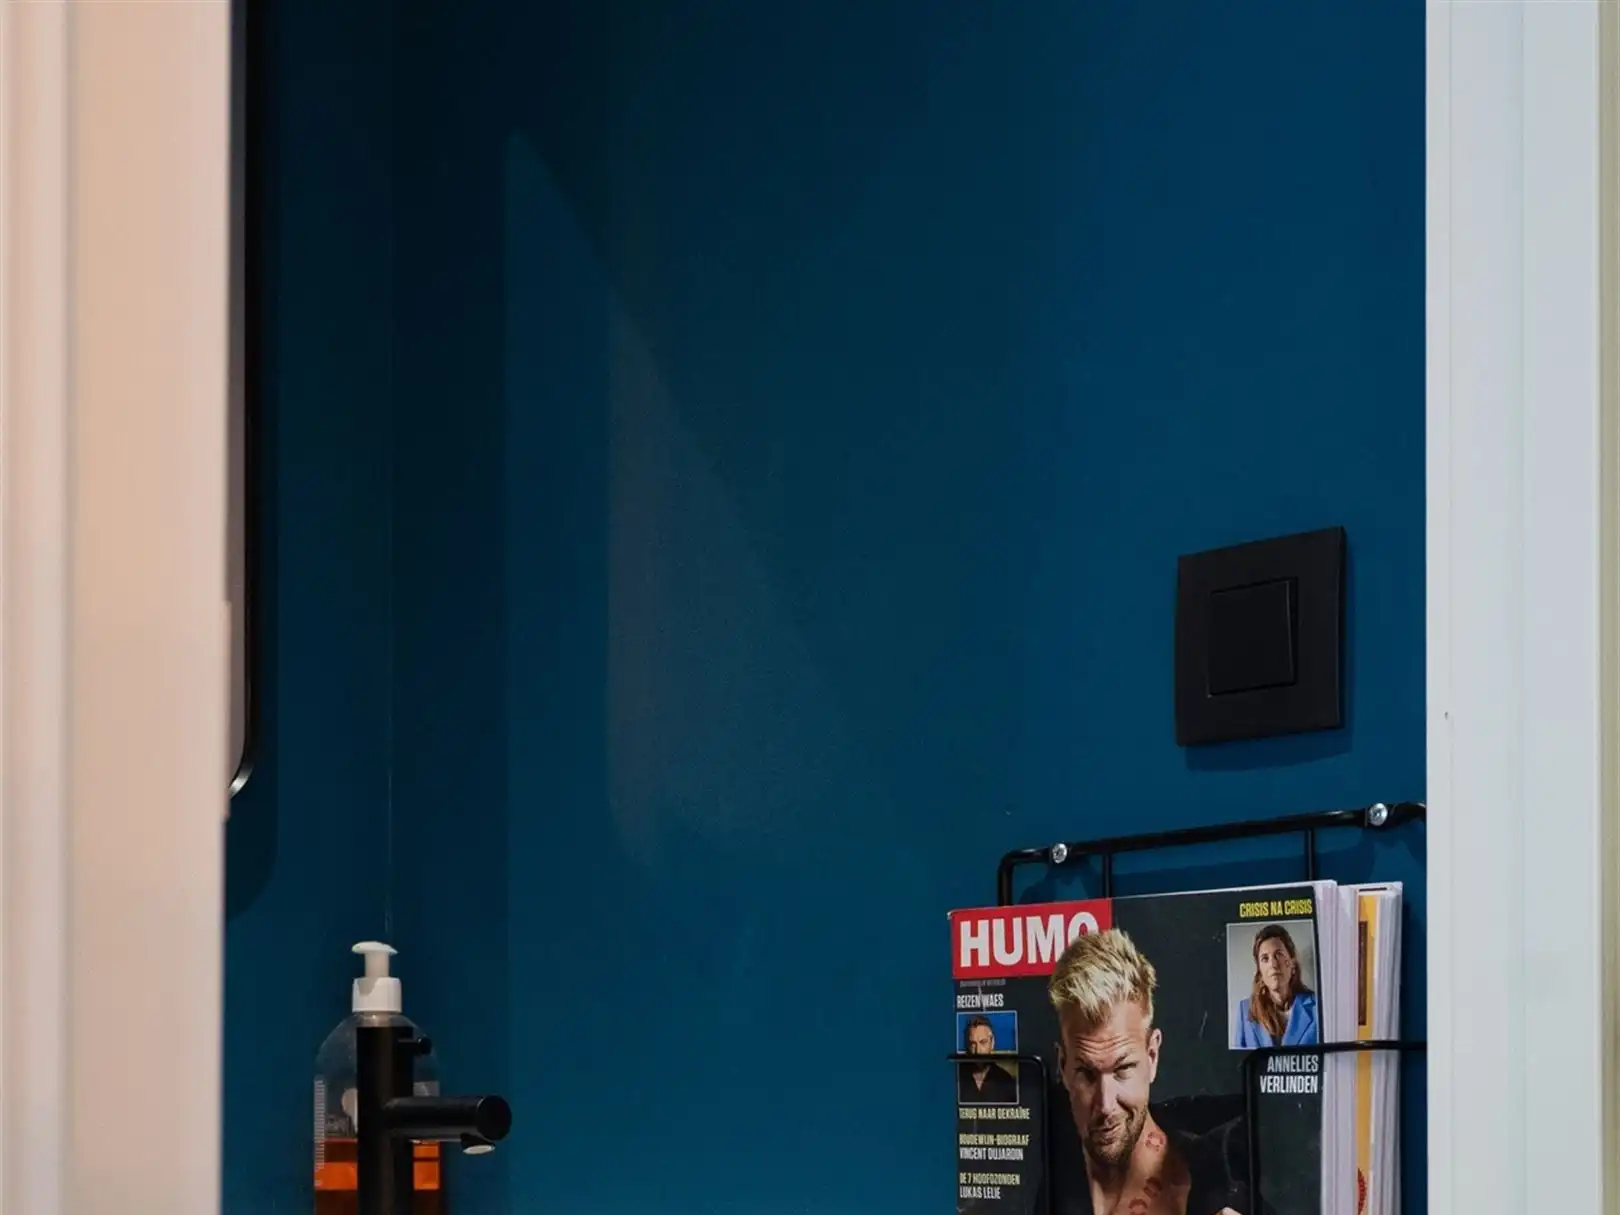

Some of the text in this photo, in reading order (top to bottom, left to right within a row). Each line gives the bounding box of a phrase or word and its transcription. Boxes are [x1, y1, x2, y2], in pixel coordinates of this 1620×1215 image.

[1240, 899, 1313, 918] CRISIS NA CRISIS
[956, 993, 1005, 1008] REIZEN WAES
[1267, 1055, 1319, 1073] ANNELIES
[1259, 1075, 1319, 1094] VERLINDEN
[959, 1147, 987, 1160] VINCENT
[960, 1186, 982, 1199] LUKAS
